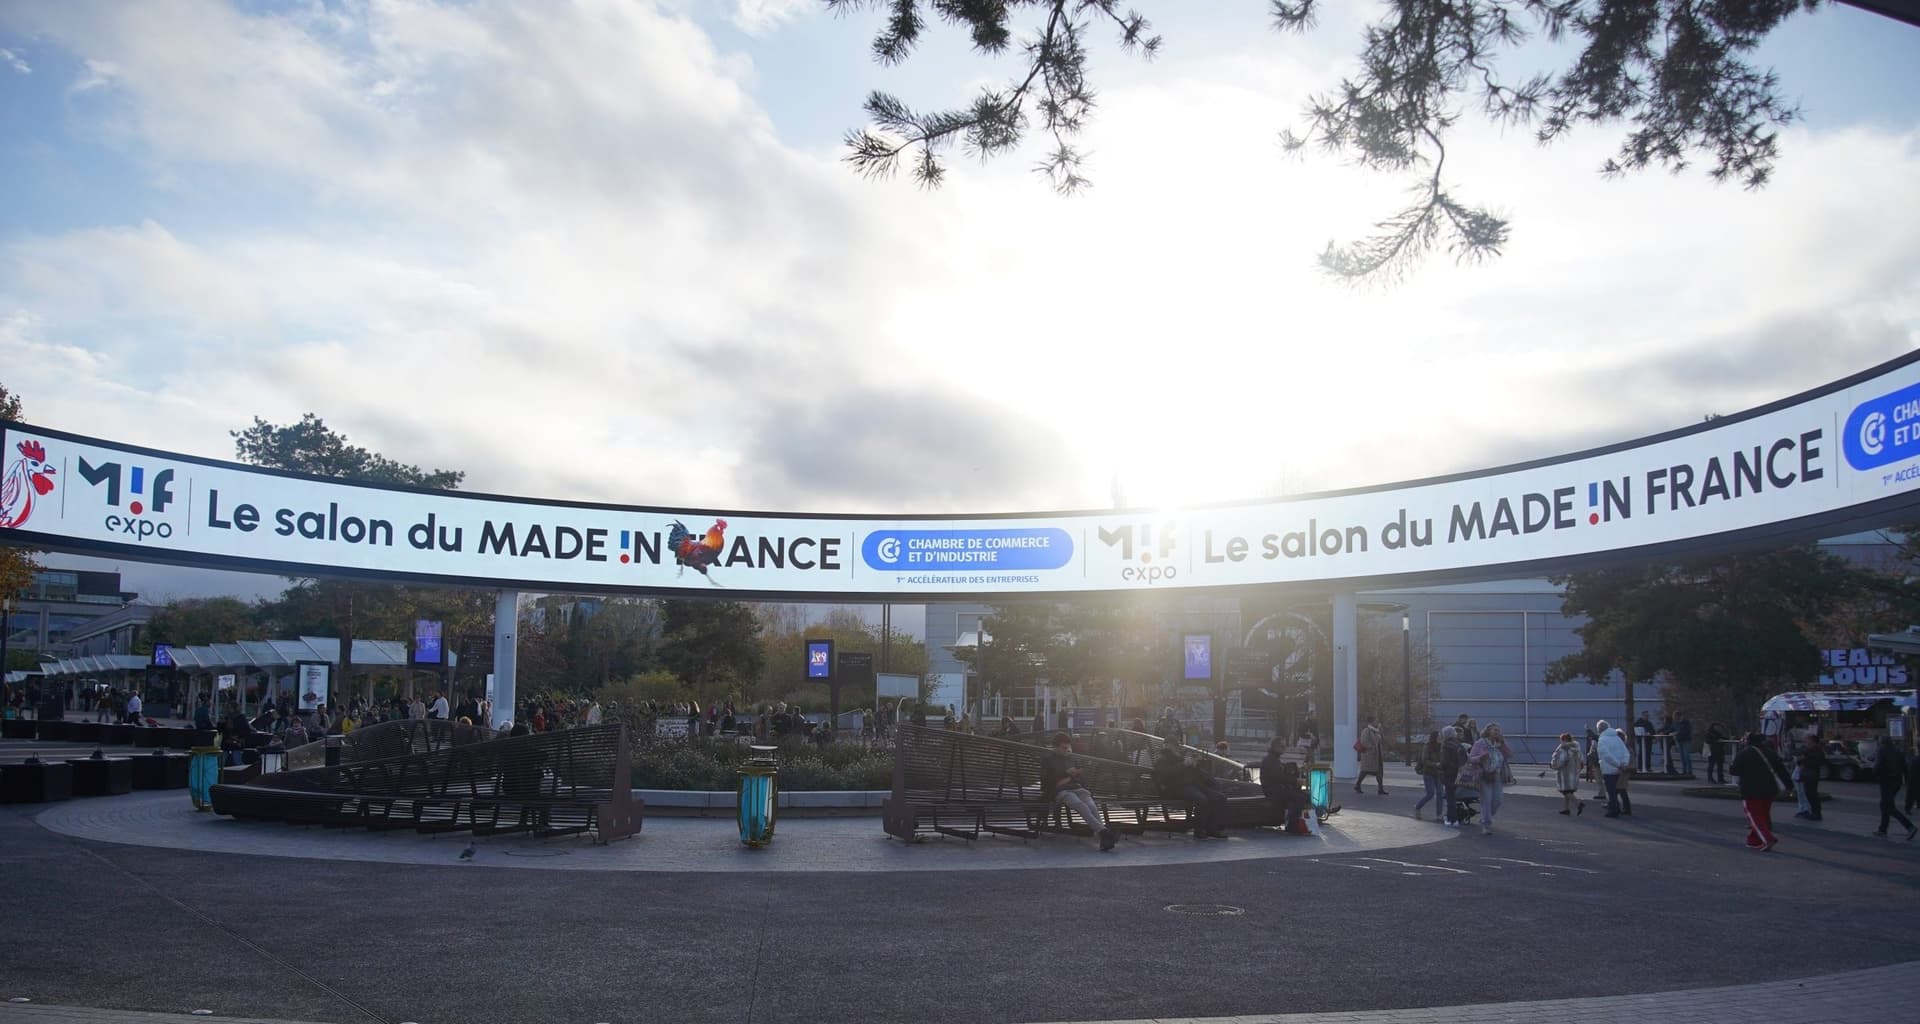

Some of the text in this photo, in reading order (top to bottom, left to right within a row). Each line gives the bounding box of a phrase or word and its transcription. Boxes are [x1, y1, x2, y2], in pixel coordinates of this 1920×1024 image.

[1893, 425, 1910, 446] ET
[1204, 528, 1249, 564] Le
[1262, 518, 1368, 561] salon
[1381, 508, 1434, 549] du
[1448, 486, 1576, 543] MADE
[1646, 428, 1824, 515] FRANCE
[105, 514, 173, 541] expo
[208, 489, 260, 532] Le
[274, 500, 394, 547] salon
[408, 513, 463, 553] du
[478, 520, 608, 562] MADE
[674, 532, 841, 570] ANCE
[908, 535, 1050, 550] CHAMBRE DE COMMERCE
[908, 551, 923, 563] ET
[907, 574, 967, 584] ACCÉLÉRATEUR
[969, 576, 985, 584] DES
[986, 575, 1040, 583] ENTREPRISES
[1121, 565, 1177, 584] expo
[1819, 665, 1908, 686] LOUIS
